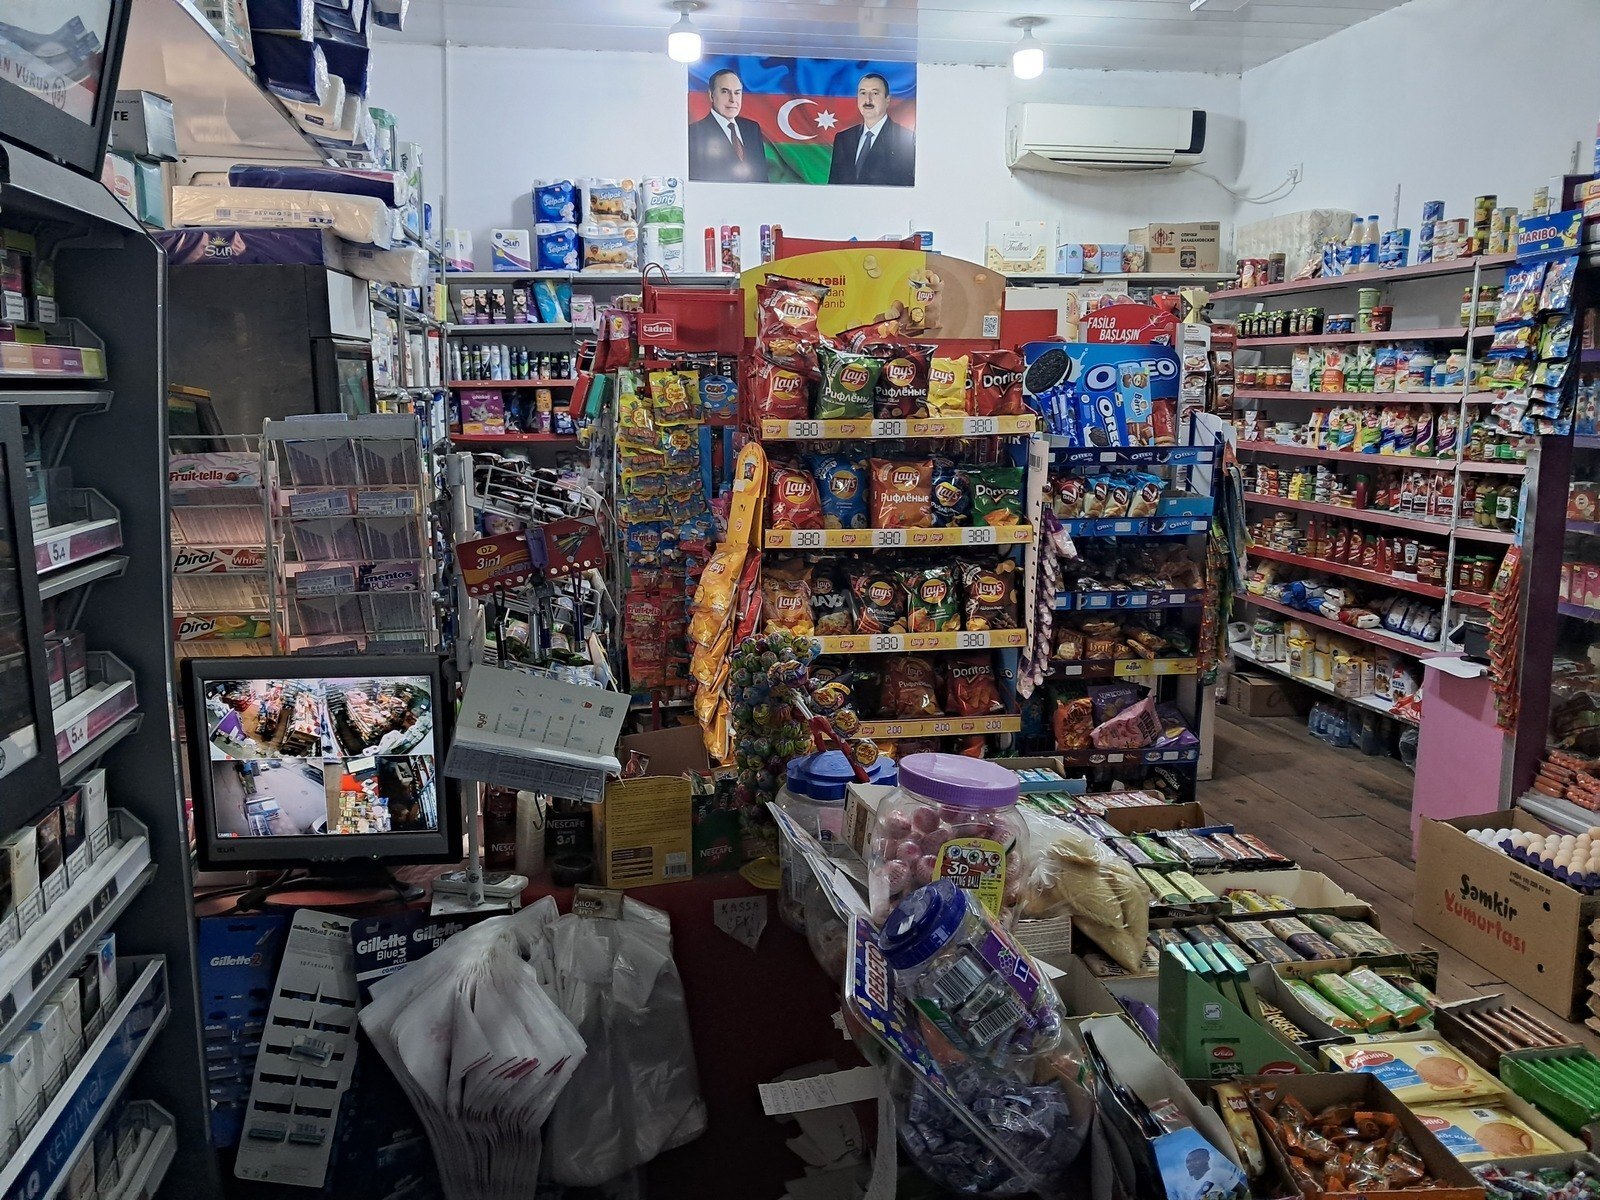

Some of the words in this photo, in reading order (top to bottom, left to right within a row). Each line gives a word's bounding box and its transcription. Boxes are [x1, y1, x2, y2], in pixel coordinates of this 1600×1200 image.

[544, 197, 566, 206] Selpak
[600, 191, 622, 200] Selpak
[502, 238, 520, 248] Sun
[1519, 227, 1558, 246] HARIBO
[205, 244, 233, 258] Sun
[548, 244, 569, 254] Selpak
[1099, 329, 1141, 342] BAŞLAŞIN
[984, 372, 1024, 388] Dorito
[1085, 358, 1177, 392] OEO
[175, 551, 215, 567] Dirol
[232, 556, 262, 566] White
[364, 570, 413, 584] mentos
[371, 580, 395, 590] PURE
[180, 620, 215, 635] Dirol
[952, 664, 990, 679] Doritos
[947, 860, 969, 875] 3D
[1459, 874, 1518, 922] Şəmkir
[722, 903, 759, 914] KASSA
[1444, 888, 1526, 955] Yumurtası
[412, 922, 464, 942] Gillette
[356, 934, 407, 955] Gillette
[210, 956, 251, 967] Gillette
[867, 943, 888, 1009] BEBETO
